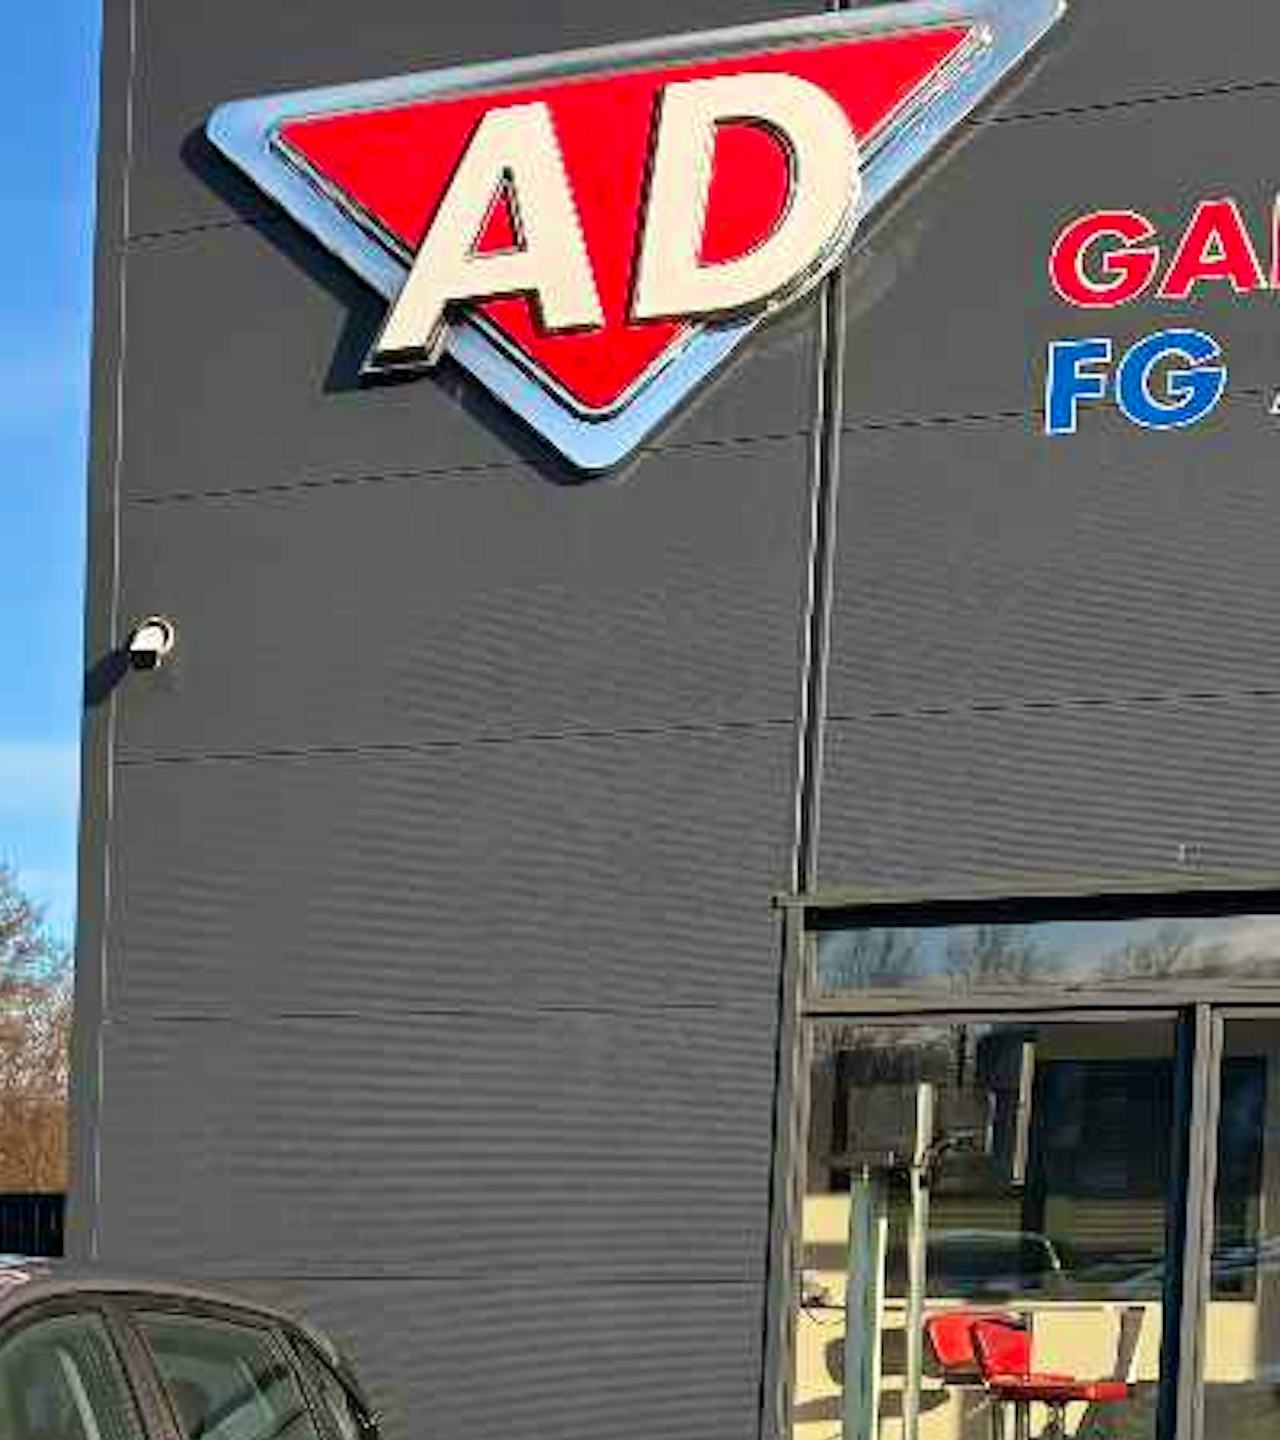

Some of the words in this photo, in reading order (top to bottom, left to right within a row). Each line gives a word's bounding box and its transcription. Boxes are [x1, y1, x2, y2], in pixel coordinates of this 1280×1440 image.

[364, 71, 861, 372] AD
[1048, 193, 1280, 308] GA
[1045, 328, 1228, 435] FG
